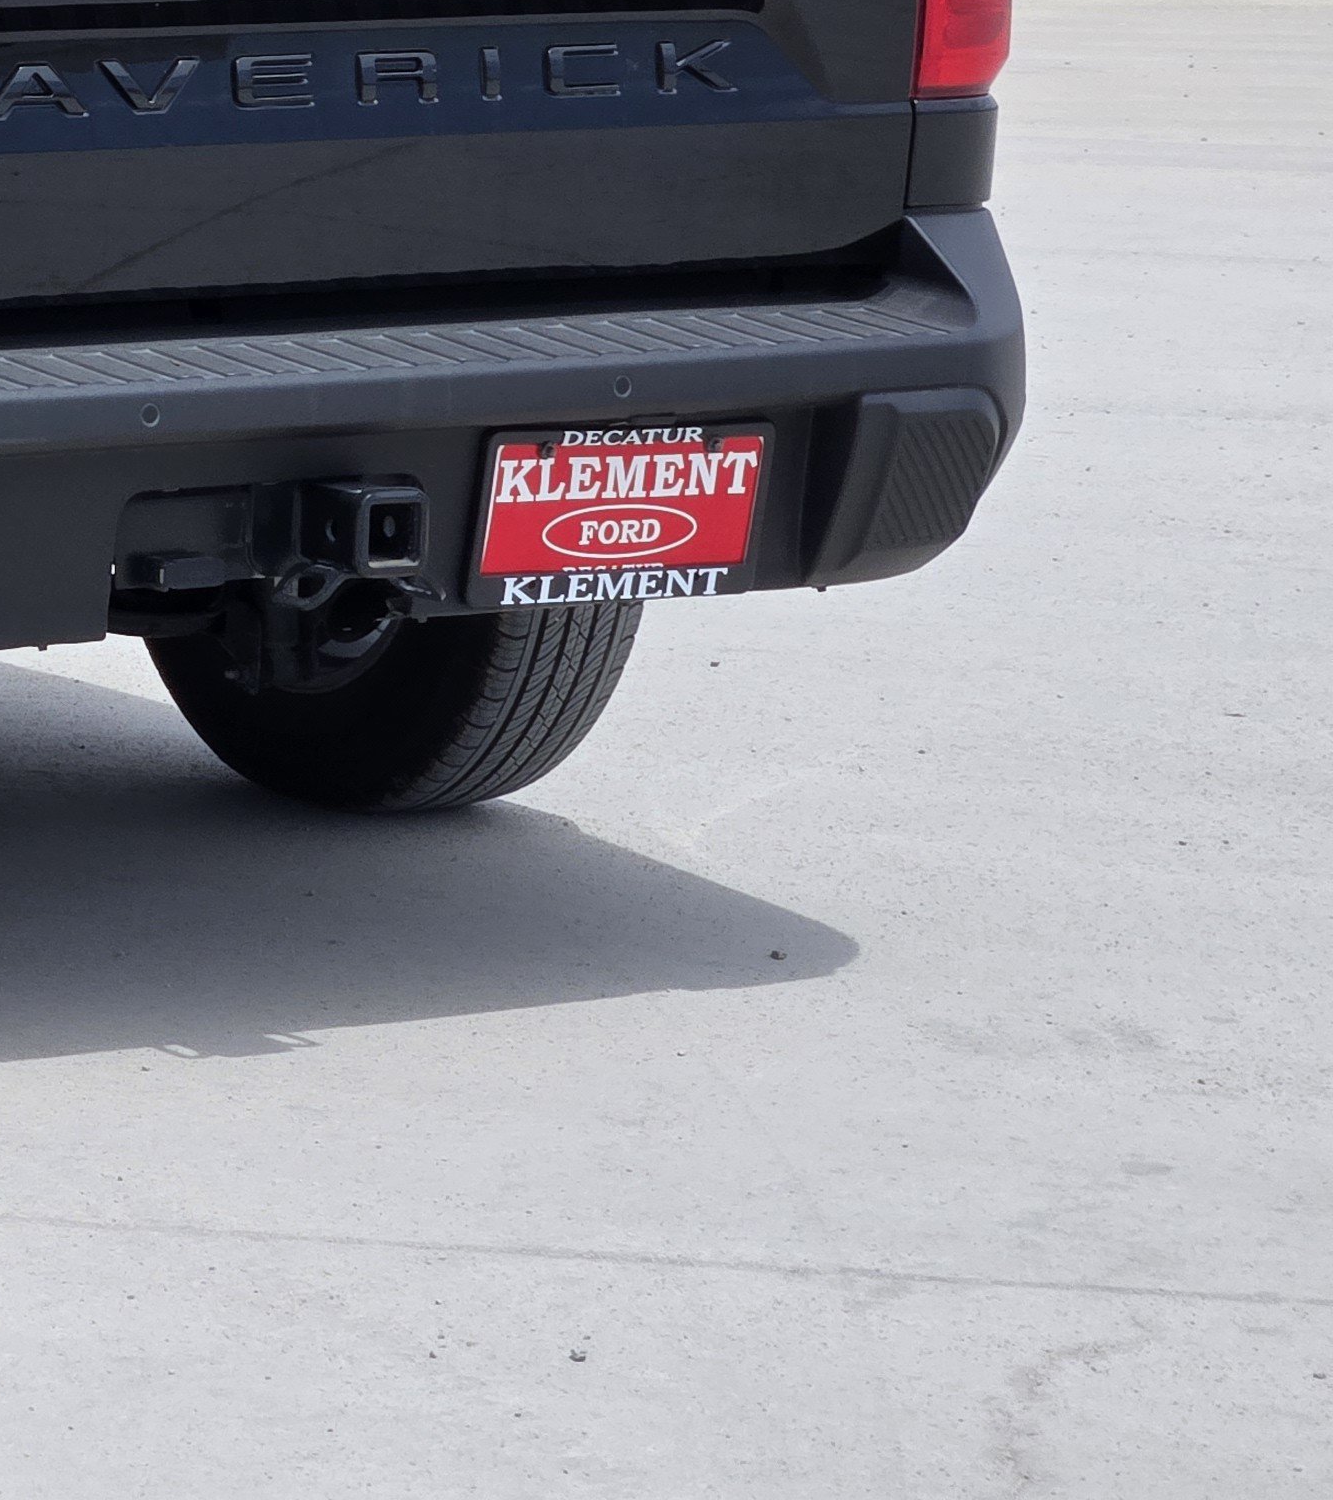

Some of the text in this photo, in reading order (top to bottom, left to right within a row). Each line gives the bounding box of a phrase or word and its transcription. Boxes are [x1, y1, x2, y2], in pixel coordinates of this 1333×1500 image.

[561, 426, 704, 447] DECATUR
[495, 451, 758, 503] KLEMENT
[578, 518, 661, 545] FORD
[500, 567, 729, 605] KLEMENT
